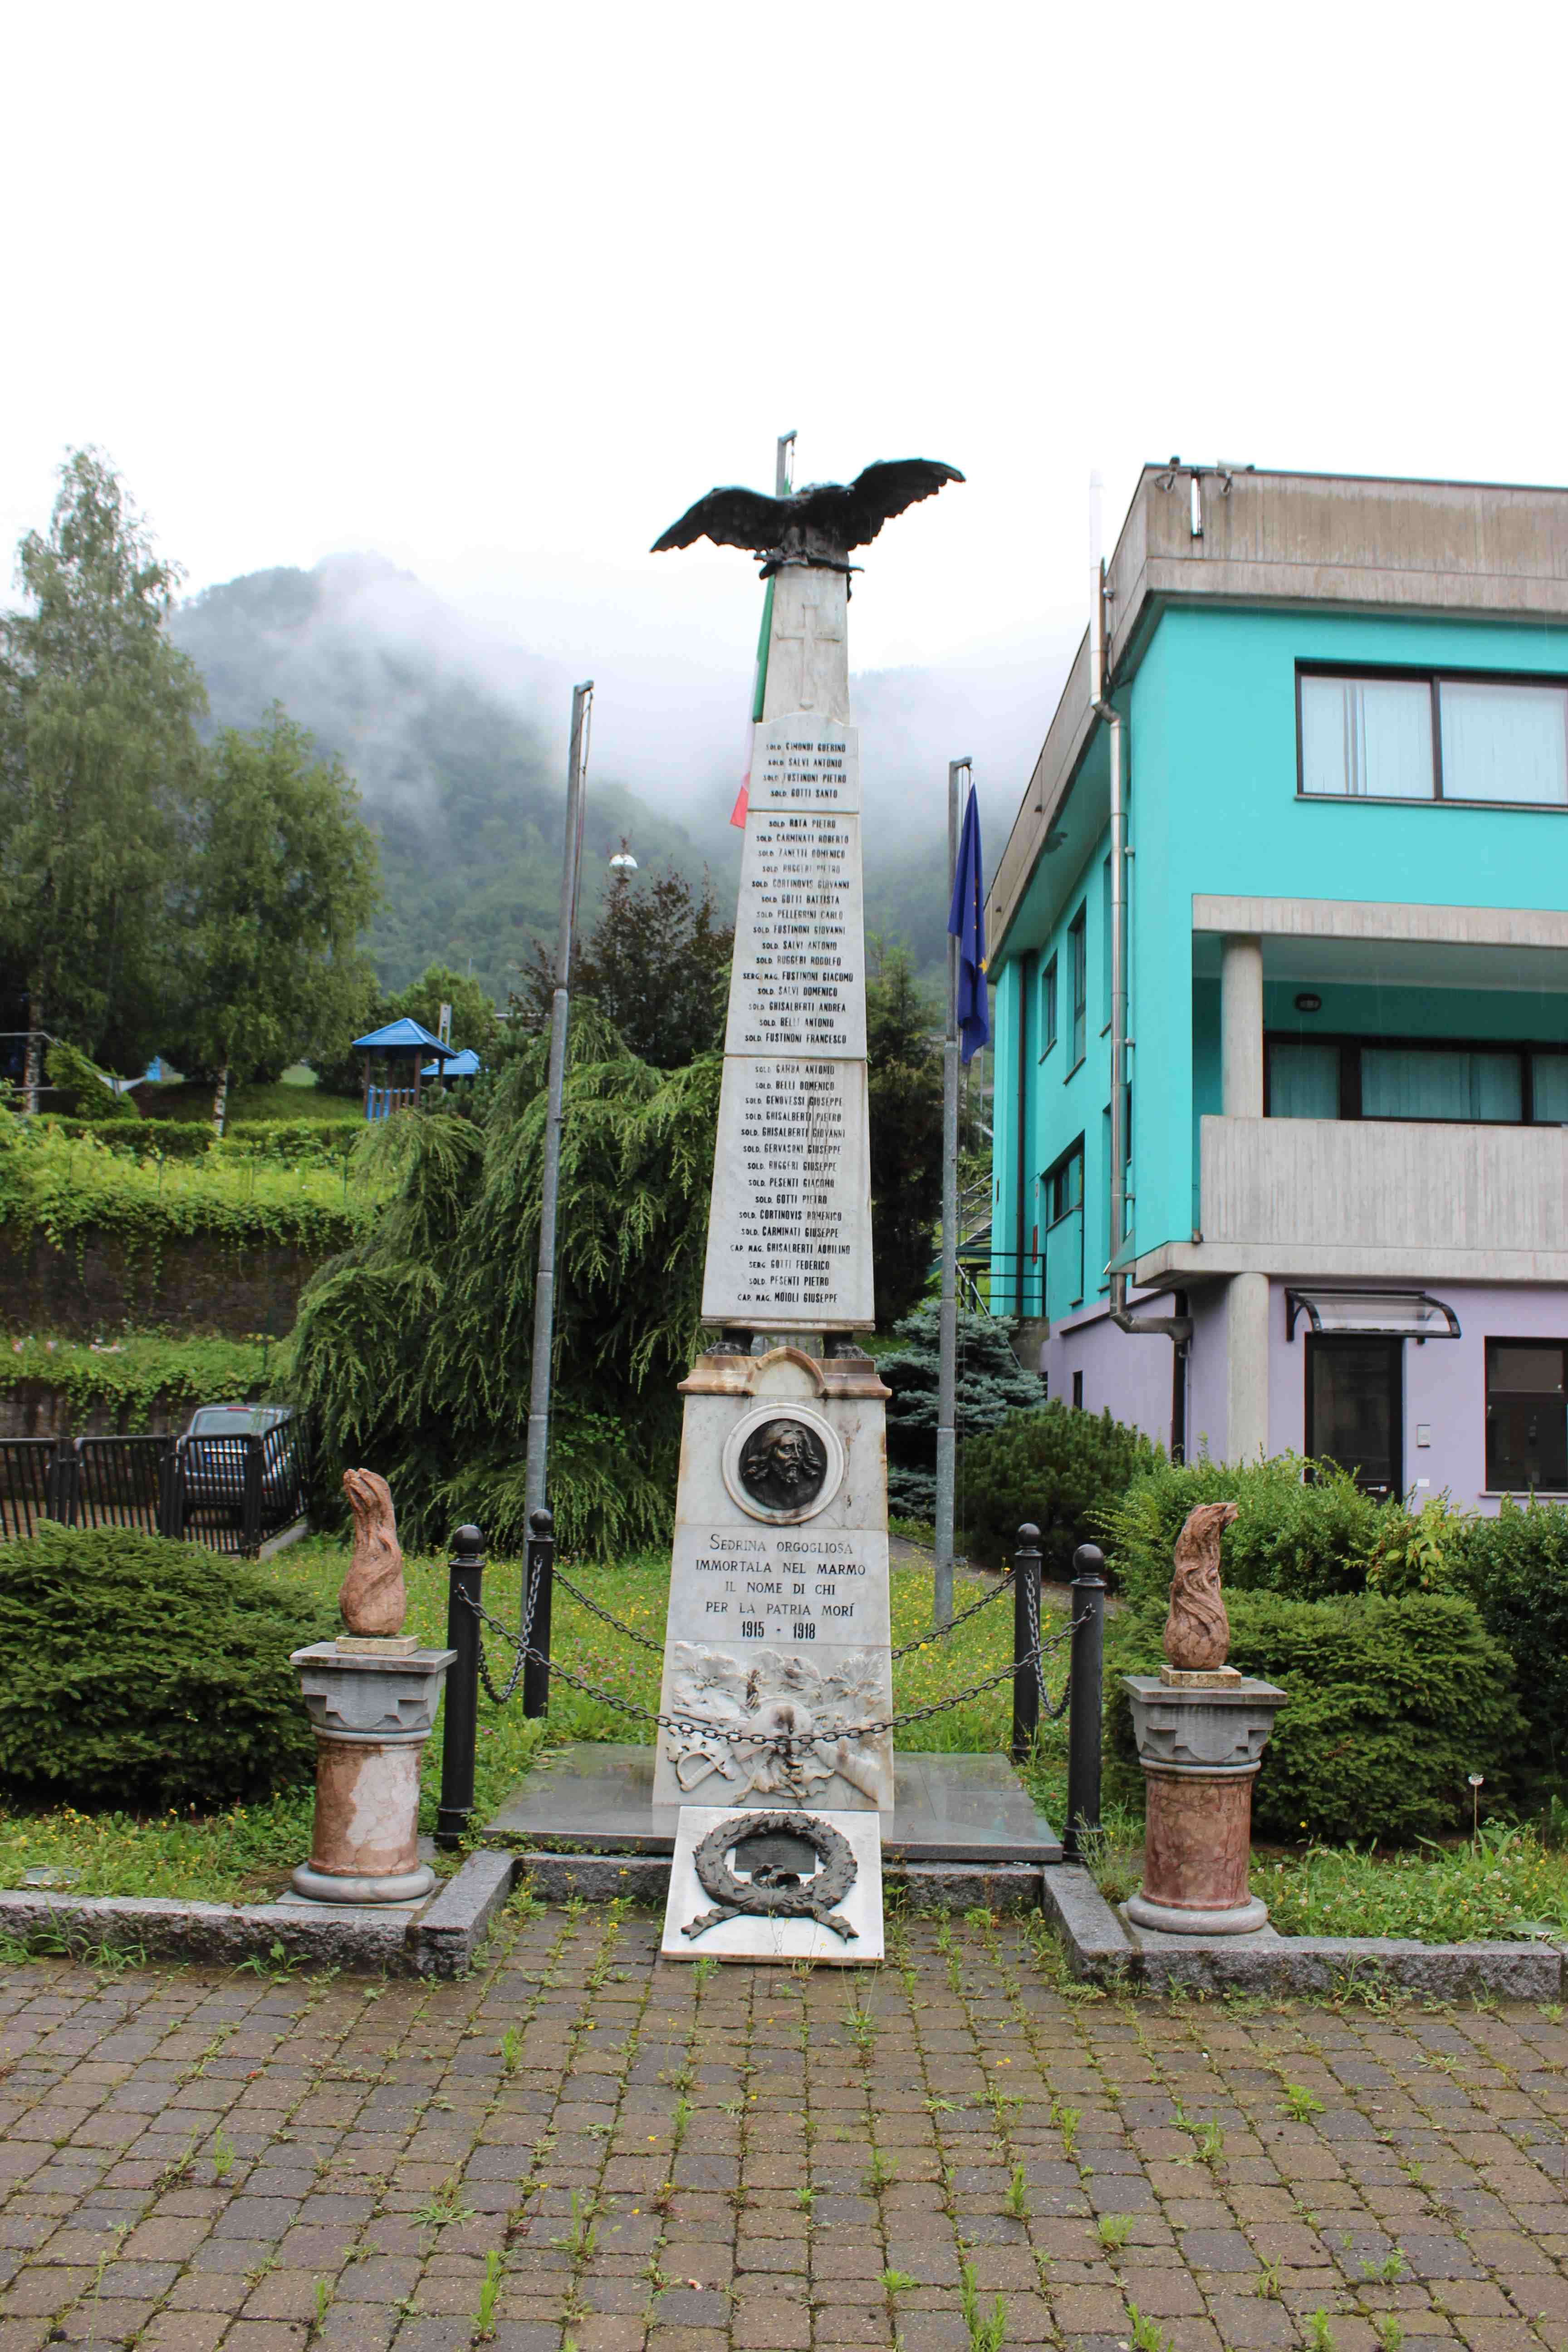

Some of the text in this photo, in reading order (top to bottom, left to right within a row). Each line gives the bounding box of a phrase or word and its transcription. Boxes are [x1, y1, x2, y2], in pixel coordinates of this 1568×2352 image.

[789, 758, 809, 767] SALVI
[813, 759, 842, 768] ANTONIO
[823, 774, 846, 783] PIETRO
[791, 789, 811, 797] GOTTI
[816, 789, 838, 798] SANTO
[812, 820, 836, 828] PIETRO
[777, 834, 813, 843] CARMINATI
[818, 835, 848, 843] ROBERTO
[812, 850, 845, 858] DOMENICO
[773, 879, 813, 888] CORTINOVIS
[818, 880, 849, 889] GIOVANNI
[782, 894, 802, 903] GOTTI
[807, 895, 839, 904] BATTISTA
[778, 909, 816, 918] PELLEGRINI
[821, 911, 843, 919] CARLO
[774, 925, 809, 933] FUSTINONI
[814, 926, 845, 935] GIOVANNI
[783, 941, 803, 950] SALVI
[808, 942, 837, 951] ANTONIO
[777, 956, 806, 965] RUGGERI
[811, 956, 841, 966] RODOLFO
[783, 971, 818, 980] FUSTINONI
[823, 972, 853, 982] GIACOMO
[779, 986, 799, 995] SALVI
[804, 987, 838, 997] DOMENICO
[769, 1002, 814, 1012] GHISALBERTI
[819, 1004, 846, 1012] ANDREA
[805, 1018, 833, 1028] ANTONIO
[766, 1032, 802, 1043] FUSTINONI
[806, 1034, 846, 1044] FRANCESCO
[776, 1064, 799, 1074] GAMBA
[805, 1065, 834, 1075] ANTONIO
[776, 1081, 795, 1090] BELLI
[800, 1082, 834, 1091] DOMENICO
[766, 1096, 804, 1105] GENOVESSI
[809, 1097, 843, 1106] GIUSEPPE
[766, 1111, 811, 1122] GHISALBERTI
[817, 1112, 841, 1122] PIETRO
[763, 1127, 808, 1137] GHISALBERTI
[813, 1128, 845, 1138] GIOVANNI
[764, 1144, 804, 1153] GERVASONI
[808, 1145, 842, 1155] GIUSEPPE
[769, 1161, 799, 1170] RUGGERI
[803, 1161, 837, 1171] GIUSEPPE
[770, 1177, 799, 1187] PESENTI
[803, 1179, 834, 1188] GIACOMO
[777, 1194, 797, 1204] GOTTI
[803, 1195, 827, 1205] PIETRO
[760, 1210, 802, 1220] CORTINOVIS
[762, 1227, 800, 1237] CARMINATI
[805, 1228, 839, 1238] GIUSEPPE
[767, 1243, 813, 1254] GHISALBERTI
[818, 1244, 850, 1254] AQUILINO
[771, 1259, 791, 1269] GOTTI
[796, 1260, 829, 1270] FEDERICO
[770, 1276, 799, 1286] PESENTI
[804, 1277, 829, 1286] PIETRO
[775, 1292, 799, 1303] MOIOLI
[804, 1293, 838, 1303] GIUSEPPE
[777, 1541, 853, 1554] ORGOGLIOSA
[696, 1559, 866, 1575] IMMORTALA NEL MARMO
[725, 1582, 835, 1595] IL NOME DI CHI
[706, 1602, 728, 1612] PER
[739, 1603, 755, 1613] LA
[767, 1604, 811, 1615] PATRIA
[742, 1621, 764, 1637] 1915
[793, 1622, 816, 1639] 1918
